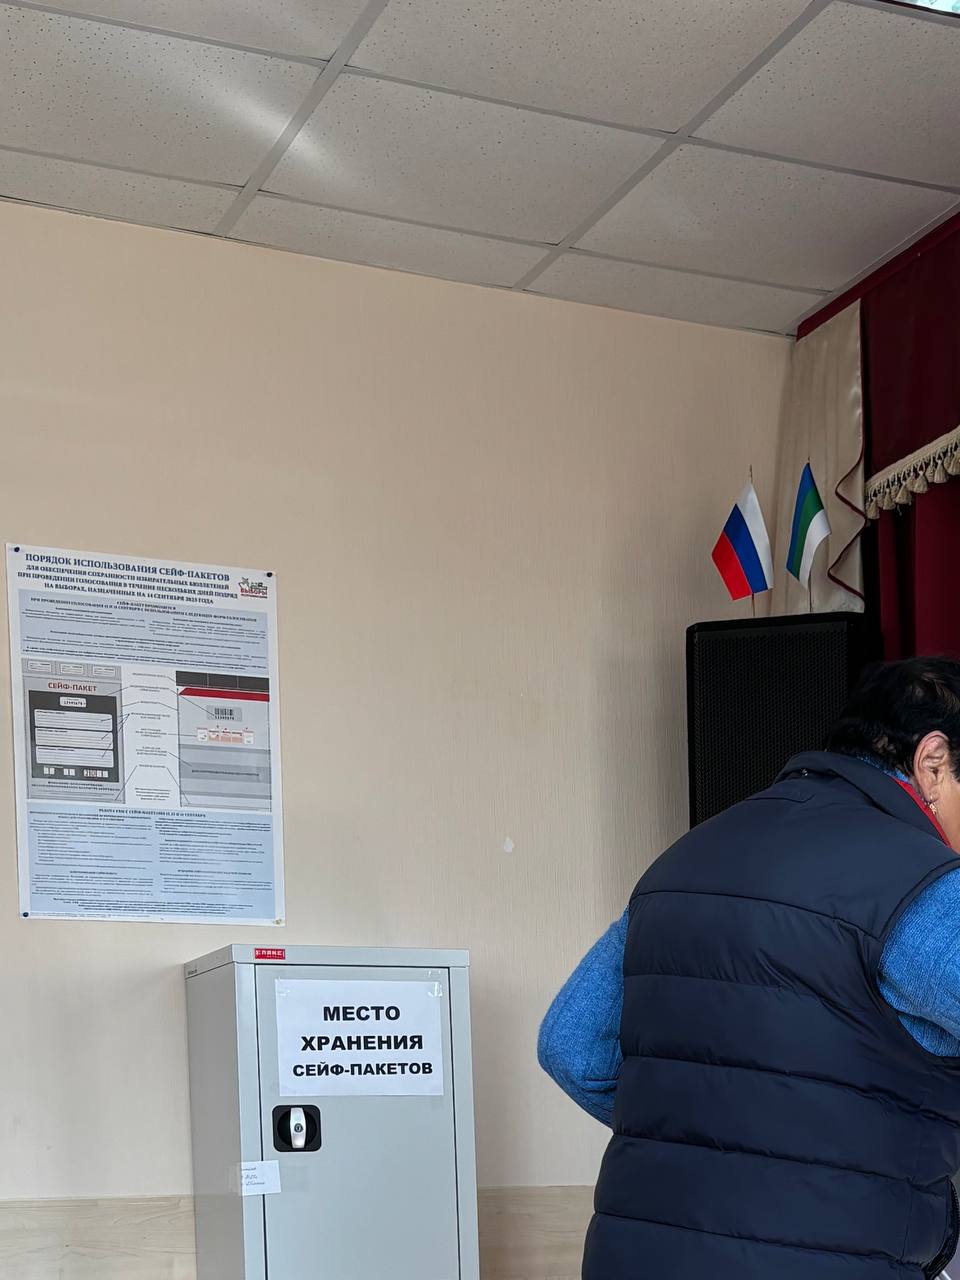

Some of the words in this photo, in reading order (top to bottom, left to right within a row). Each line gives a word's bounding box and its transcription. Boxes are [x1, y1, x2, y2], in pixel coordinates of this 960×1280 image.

[25, 553, 71, 565] ПОРЯДОК
[74, 558, 157, 574] ИСПОЛЬЗОВАНИЯ
[159, 567, 230, 581] СЕЙФ-ПАКЕТОВ
[48, 681, 97, 692] СЕЙФ-ПАКЕТ
[323, 1005, 401, 1022] МЕСТО
[301, 1035, 424, 1051] ХРАНЕНИЯ
[292, 1061, 433, 1077] СЕЙФ-ПАКЕТОВ
